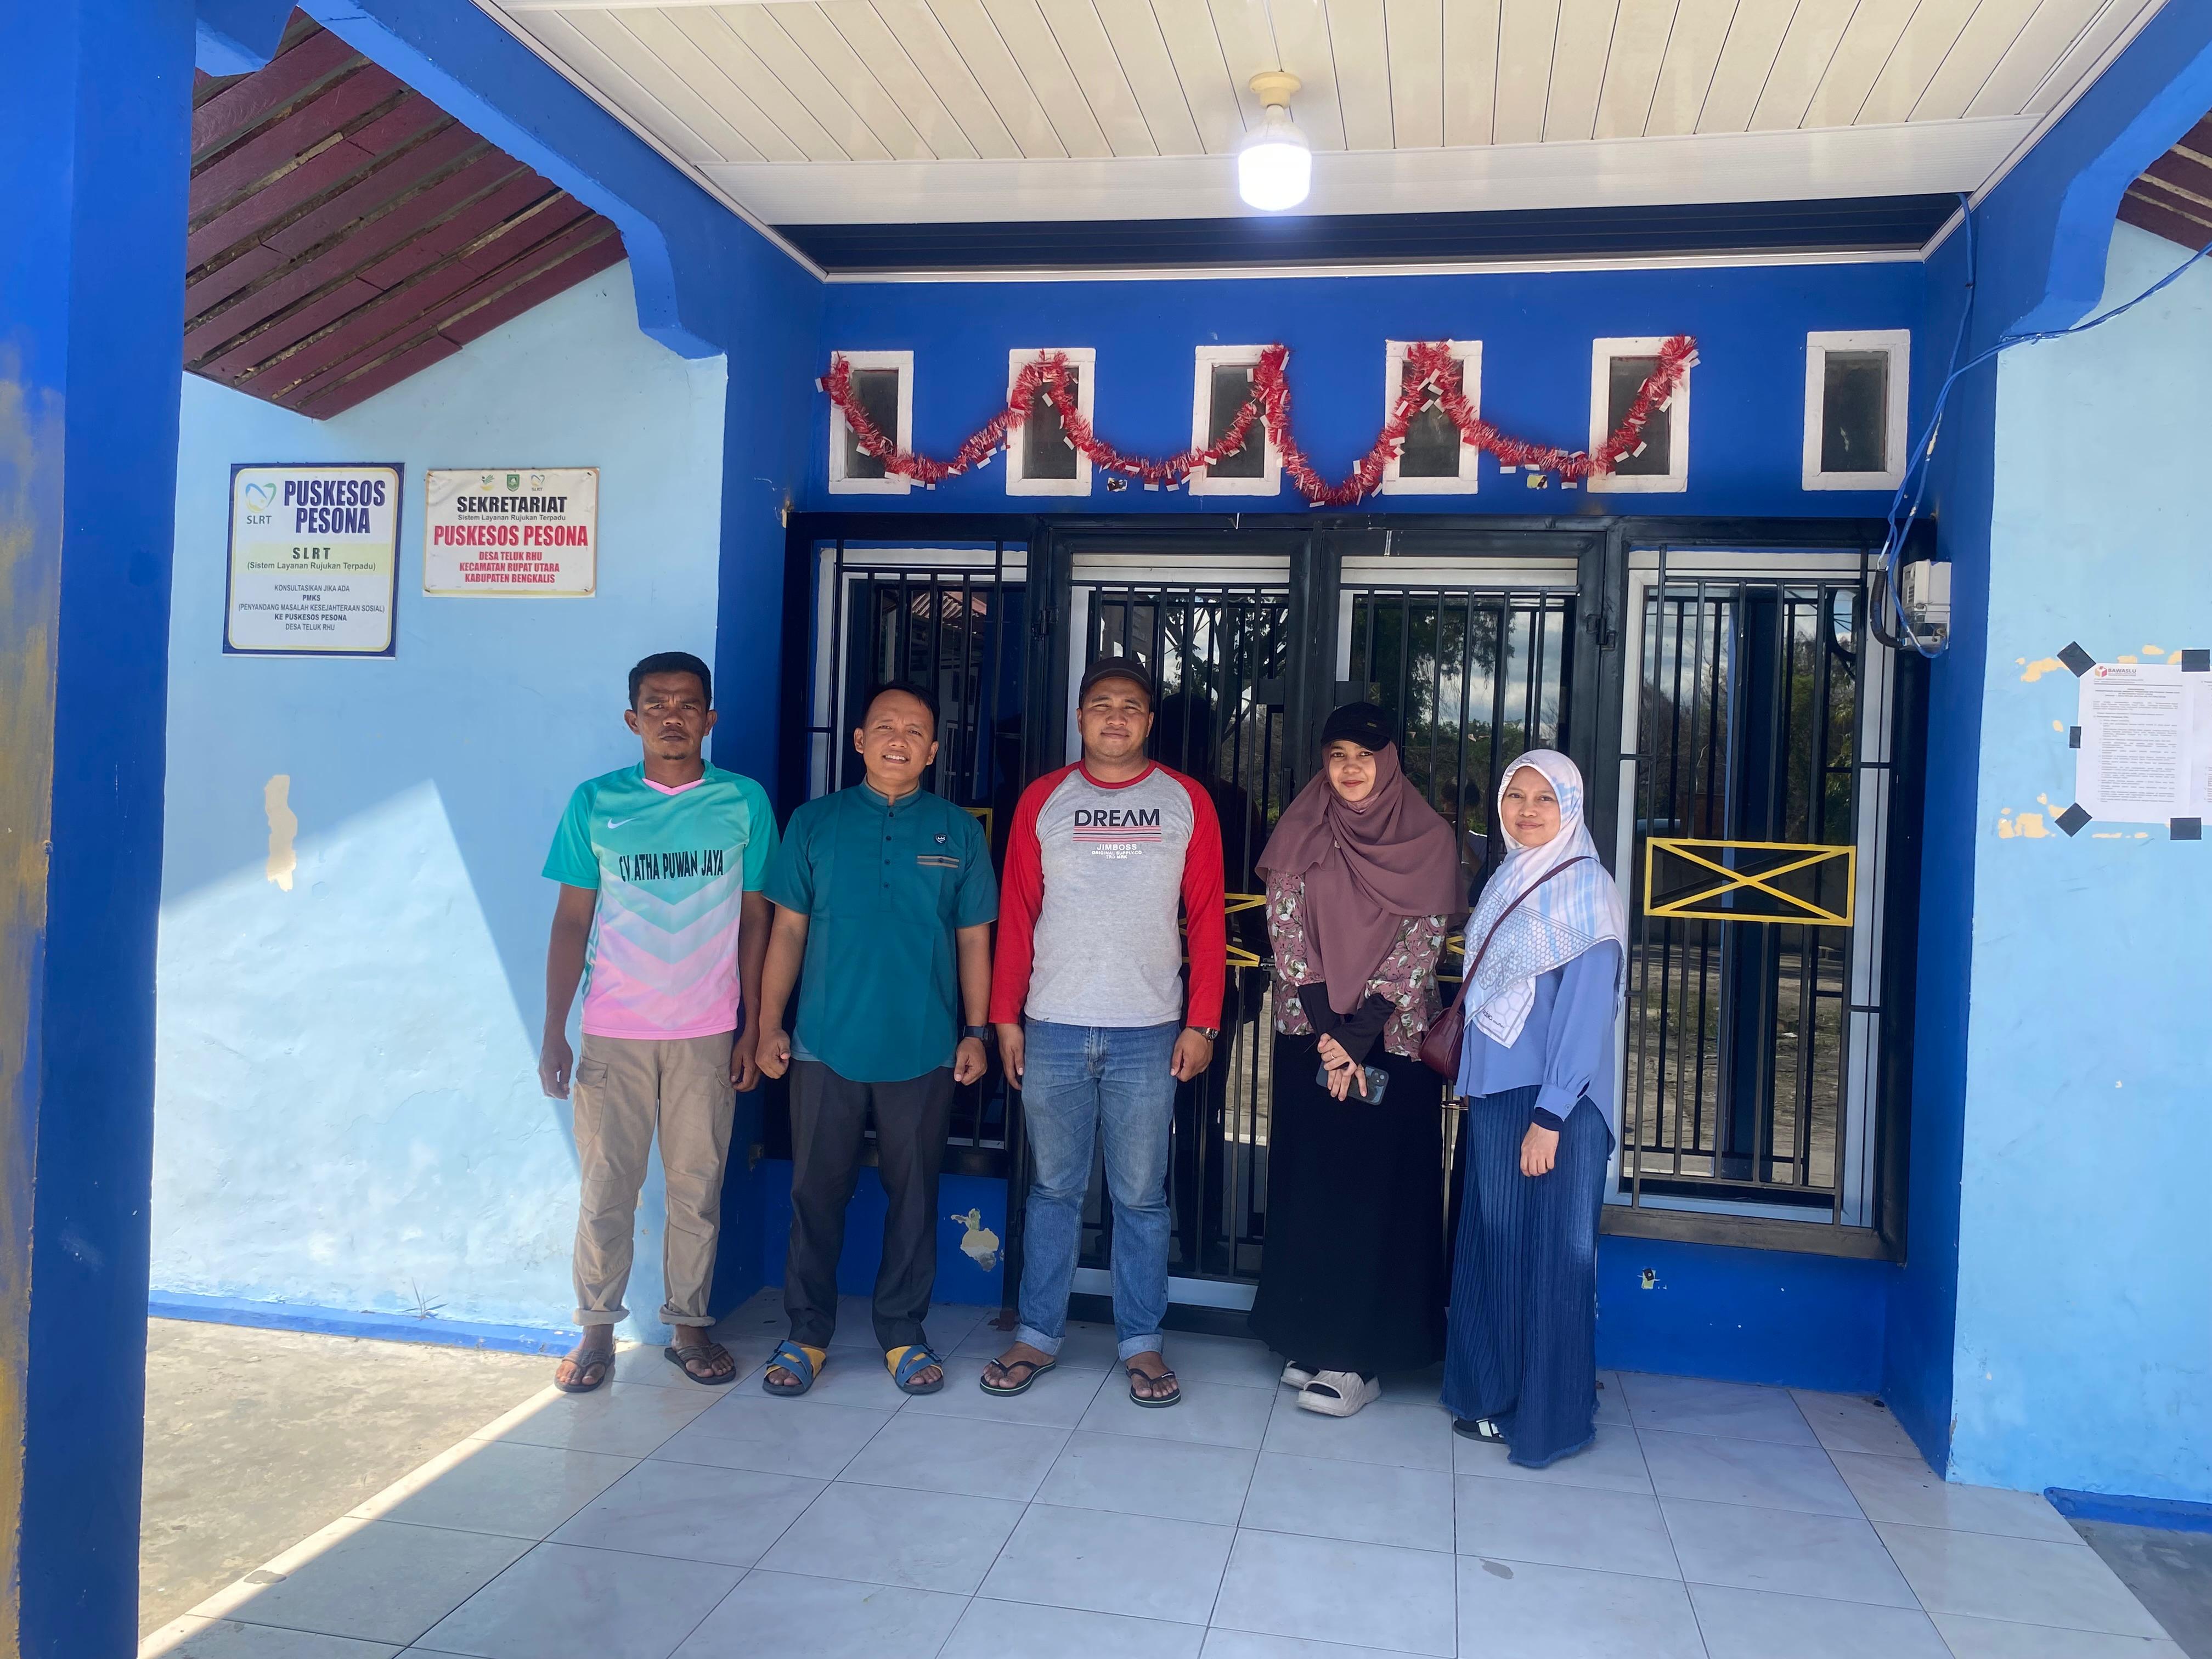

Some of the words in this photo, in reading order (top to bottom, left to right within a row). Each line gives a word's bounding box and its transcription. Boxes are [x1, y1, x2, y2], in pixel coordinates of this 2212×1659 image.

[284, 480, 386, 506] PUSKESOS
[457, 496, 567, 513] SEKRETARIAT
[246, 515, 272, 524] SLRT
[295, 507, 371, 534] PESONA
[434, 526, 519, 546] PUSKESOS
[523, 526, 588, 546] PESONA
[479, 551, 499, 561] DESA
[500, 552, 523, 561] TELUK
[526, 552, 542, 561] RHU
[247, 562, 275, 570] (Sistem
[277, 562, 308, 571] Layanan
[311, 562, 341, 571] Rujukan
[343, 562, 376, 571] Terpadu)
[460, 563, 505, 572] KECAMATAN
[507, 563, 532, 572] RUPAT
[534, 563, 560, 572] UTARA
[465, 574, 510, 583] KABUPATEN
[511, 574, 555, 584] BENGKALIS
[1074, 809, 1160, 826] DREAM
[662, 850, 698, 879] PUWAN
[701, 850, 724, 876] JAYA
